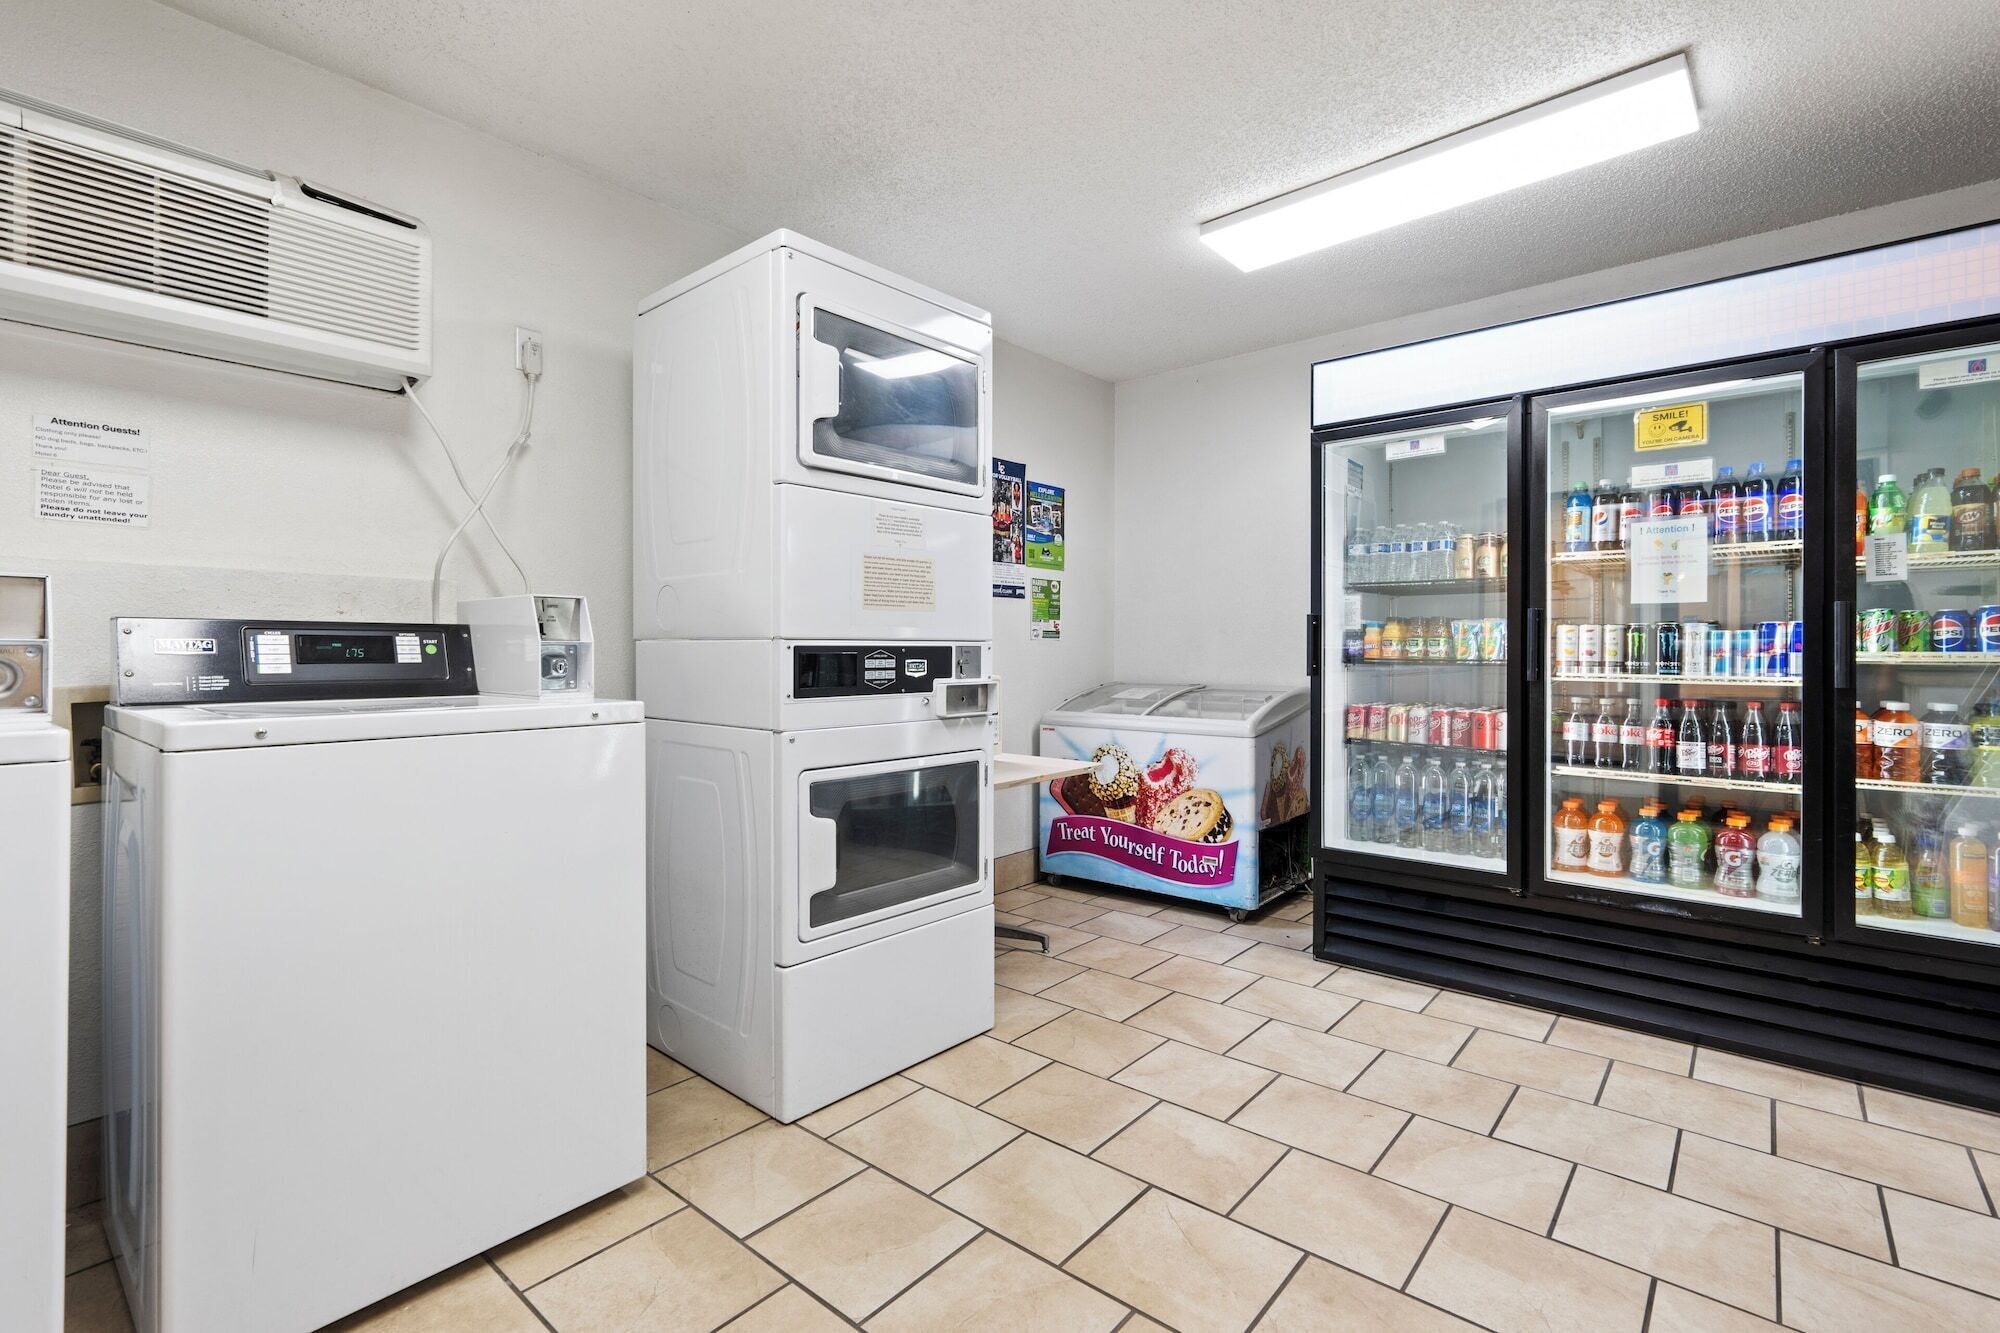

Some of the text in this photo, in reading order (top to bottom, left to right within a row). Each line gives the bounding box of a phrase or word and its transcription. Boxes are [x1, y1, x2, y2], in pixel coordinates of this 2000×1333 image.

[1652, 410, 1688, 422] SMILE!
[50, 417, 140, 436] Attention Guests!
[63, 472, 90, 480] Guest,
[82, 481, 112, 489] advised
[40, 491, 87, 500] responsible
[40, 510, 130, 523] laundry unattended!
[1646, 524, 1689, 534] Attention
[158, 640, 213, 649] MAYTAG
[1877, 727, 1913, 736] ZERO
[1925, 728, 1962, 737] ZERO
[1057, 822, 1224, 877] Treat Yourself Today!
[1771, 868, 1798, 878] ZERO
